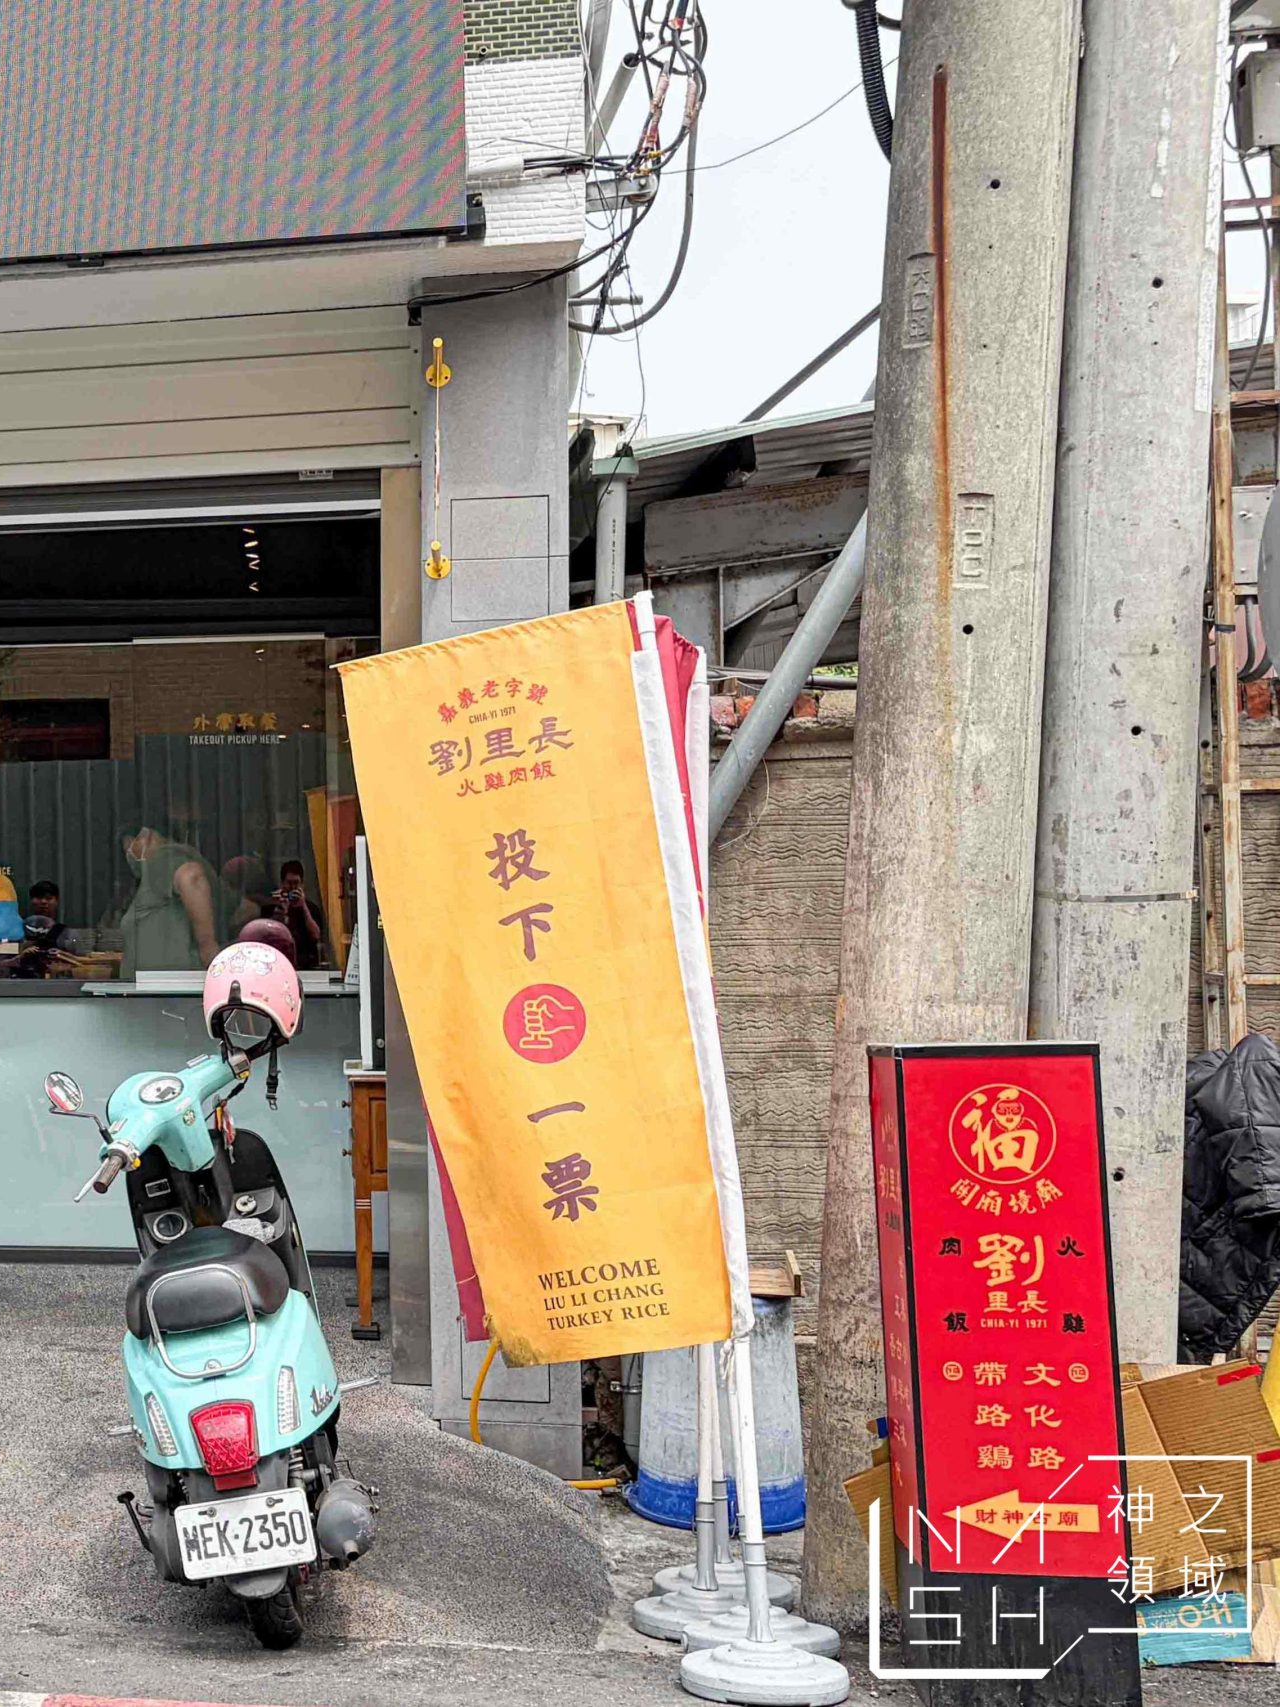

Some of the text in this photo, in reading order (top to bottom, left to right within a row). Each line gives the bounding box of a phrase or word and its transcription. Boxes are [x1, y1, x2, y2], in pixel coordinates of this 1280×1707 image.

[500, 706, 516, 717] 1971
[189, 735, 280, 745] TAKEOUT PICKUP HERE
[428, 716, 575, 776] 劉里長
[973, 1233, 1044, 1287] 劉
[538, 1259, 660, 1290] WELCOME
[544, 1283, 664, 1310] LIU LI CHANG
[983, 1290, 1048, 1313] 里長
[547, 1303, 670, 1330] TURKEY RICE
[980, 1318, 1047, 1328] CHIA-YI 1971
